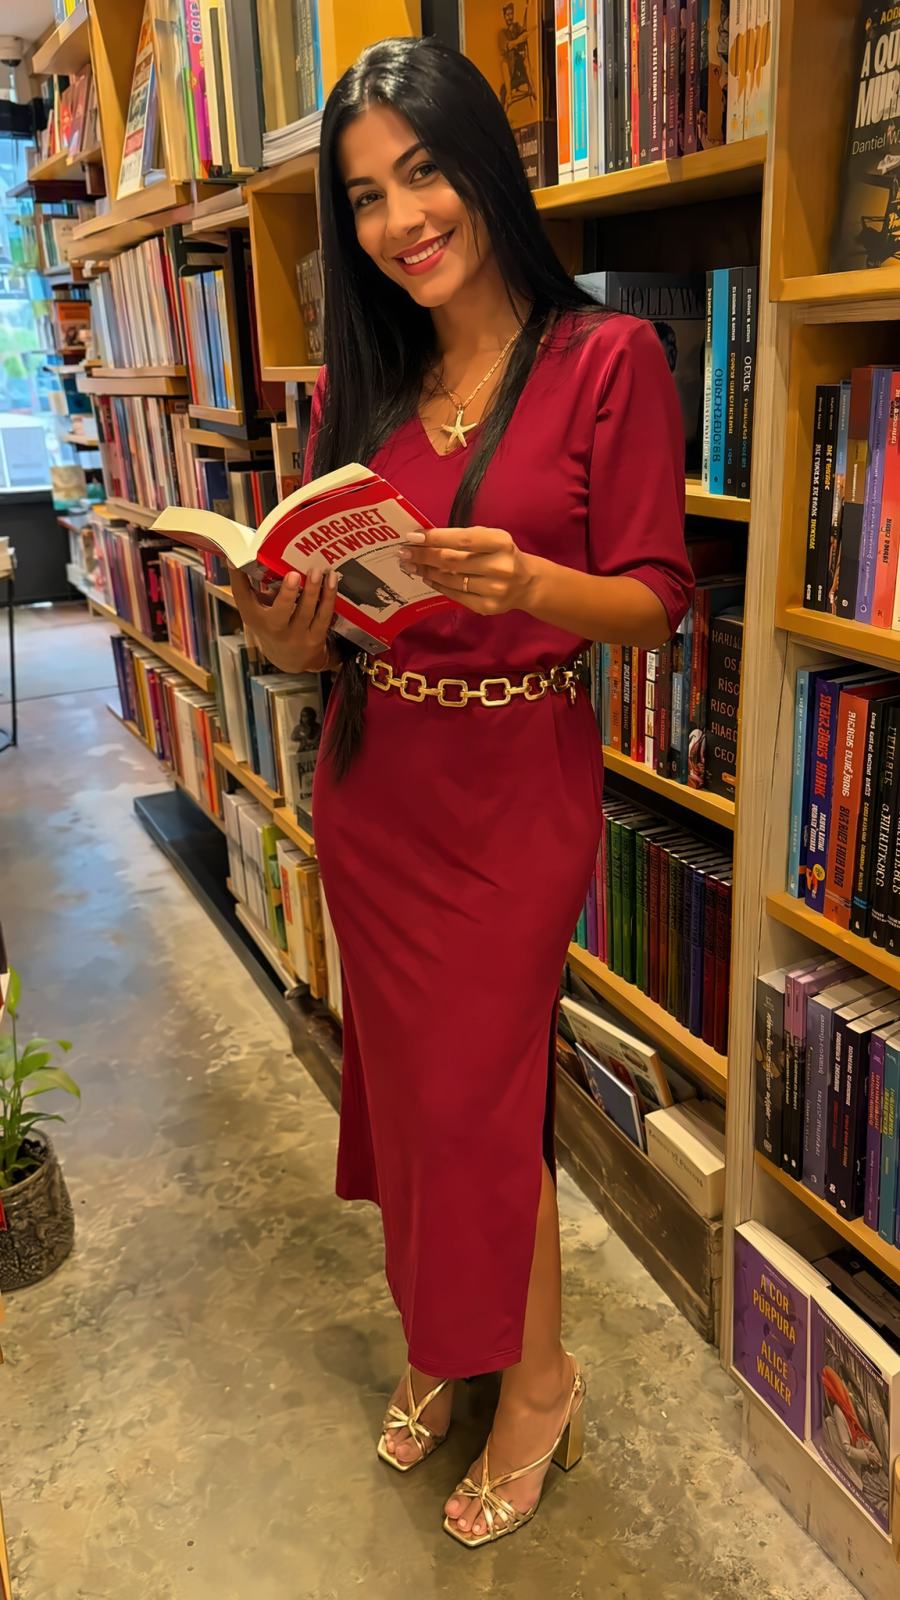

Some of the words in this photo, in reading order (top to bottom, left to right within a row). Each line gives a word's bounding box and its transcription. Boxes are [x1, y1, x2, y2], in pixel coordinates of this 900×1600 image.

[860, 41, 871, 78] A
[874, 29, 900, 74] QU
[855, 69, 900, 128] MUR
[852, 132, 886, 155] Dantiel
[294, 508, 387, 557] MARGARET
[320, 525, 400, 565] ATWOOD
[760, 1274, 767, 1293] A
[769, 1281, 789, 1315] COR
[756, 1355, 792, 1407] WALKER
[760, 1340, 788, 1380] ALICE
